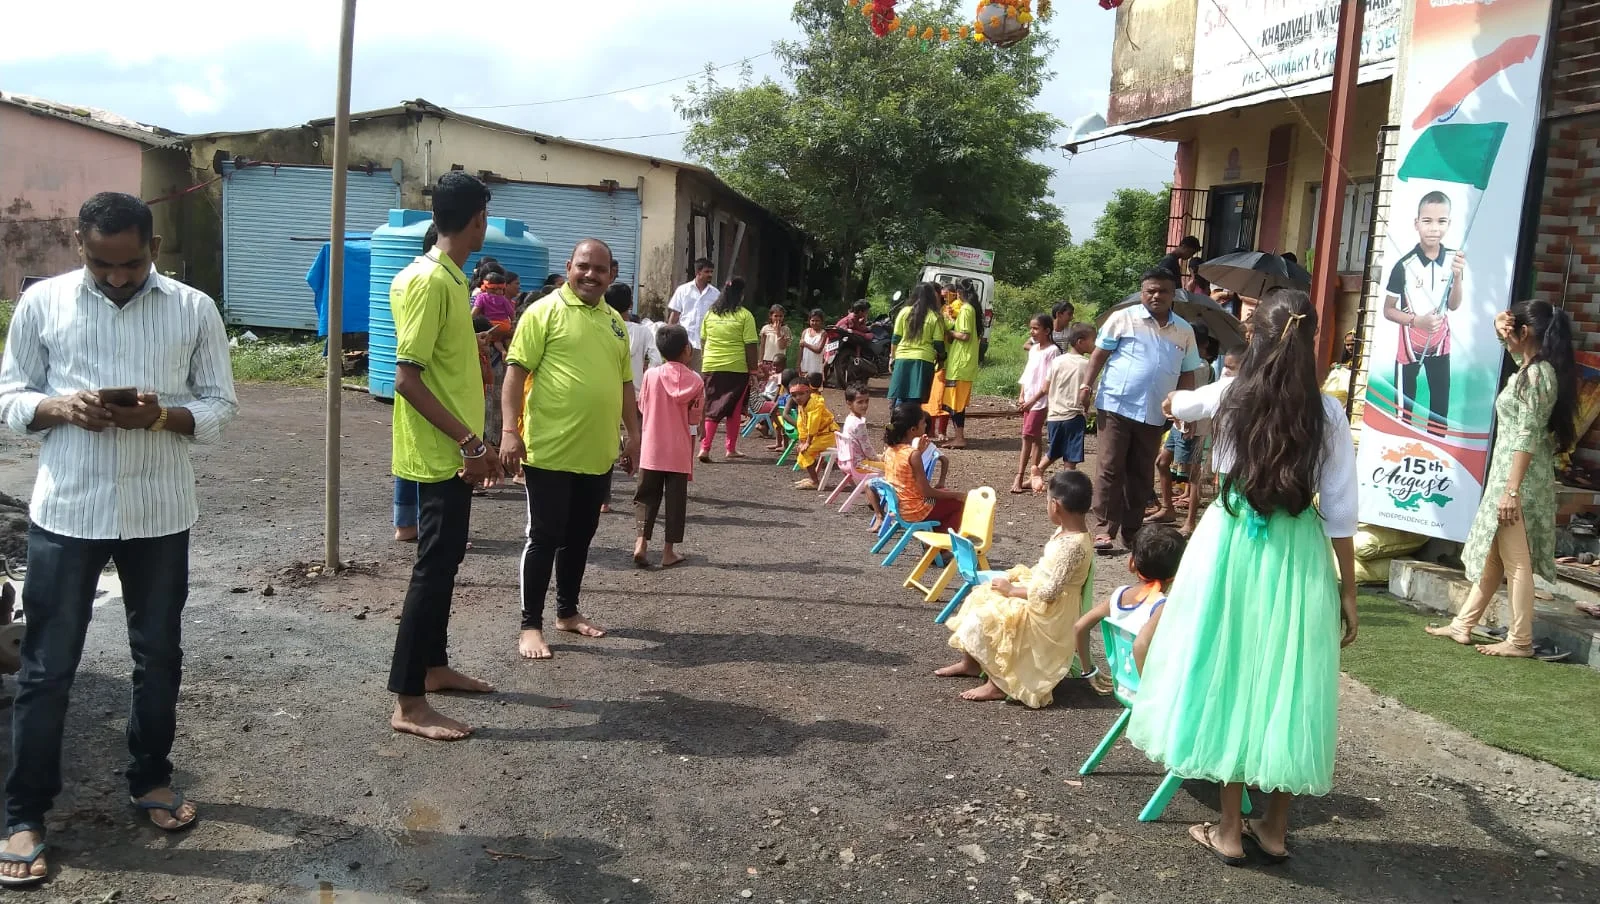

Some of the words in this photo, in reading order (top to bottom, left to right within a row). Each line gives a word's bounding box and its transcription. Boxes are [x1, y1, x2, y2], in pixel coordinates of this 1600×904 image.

[1261, 13, 1313, 48] KHADAVALI
[1403, 457, 1443, 475] 15th
[1372, 466, 1453, 500] August
[1378, 511, 1429, 526] INDEPENDENCE
[1430, 520, 1446, 529] DAY
